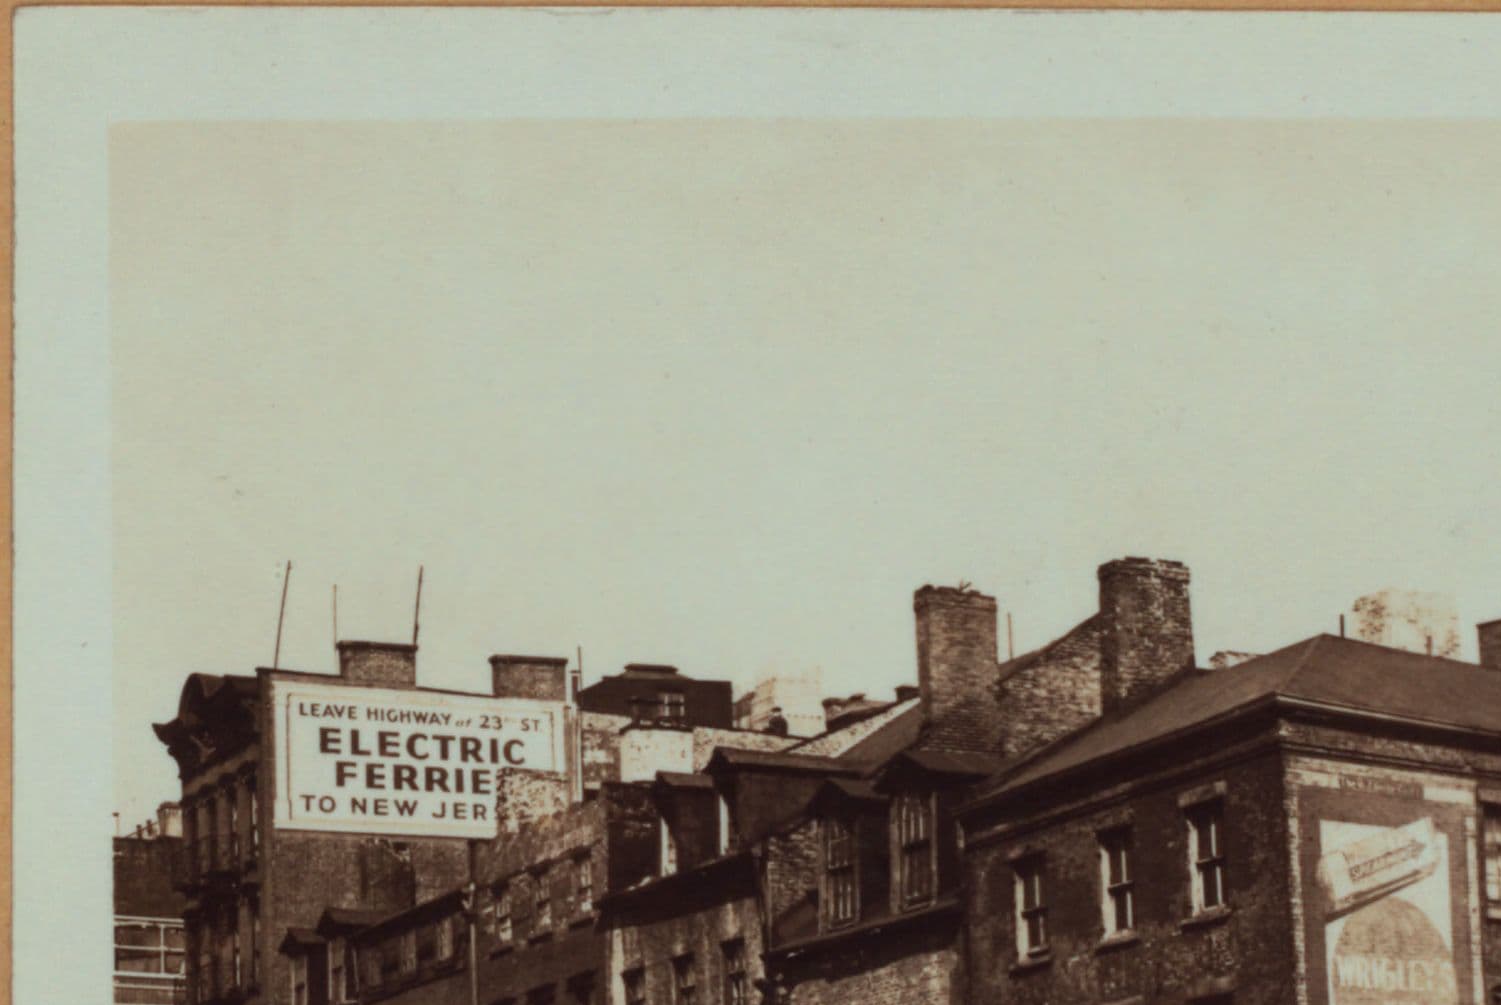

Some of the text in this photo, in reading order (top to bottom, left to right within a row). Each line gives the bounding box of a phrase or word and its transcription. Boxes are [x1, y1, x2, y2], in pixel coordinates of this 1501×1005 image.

[299, 702, 357, 720] LEAVE
[366, 708, 451, 727] HIGHWAY
[319, 727, 526, 765] ELECTRIC
[335, 761, 491, 795] FERRIE
[300, 794, 487, 821] TO NEW JER
